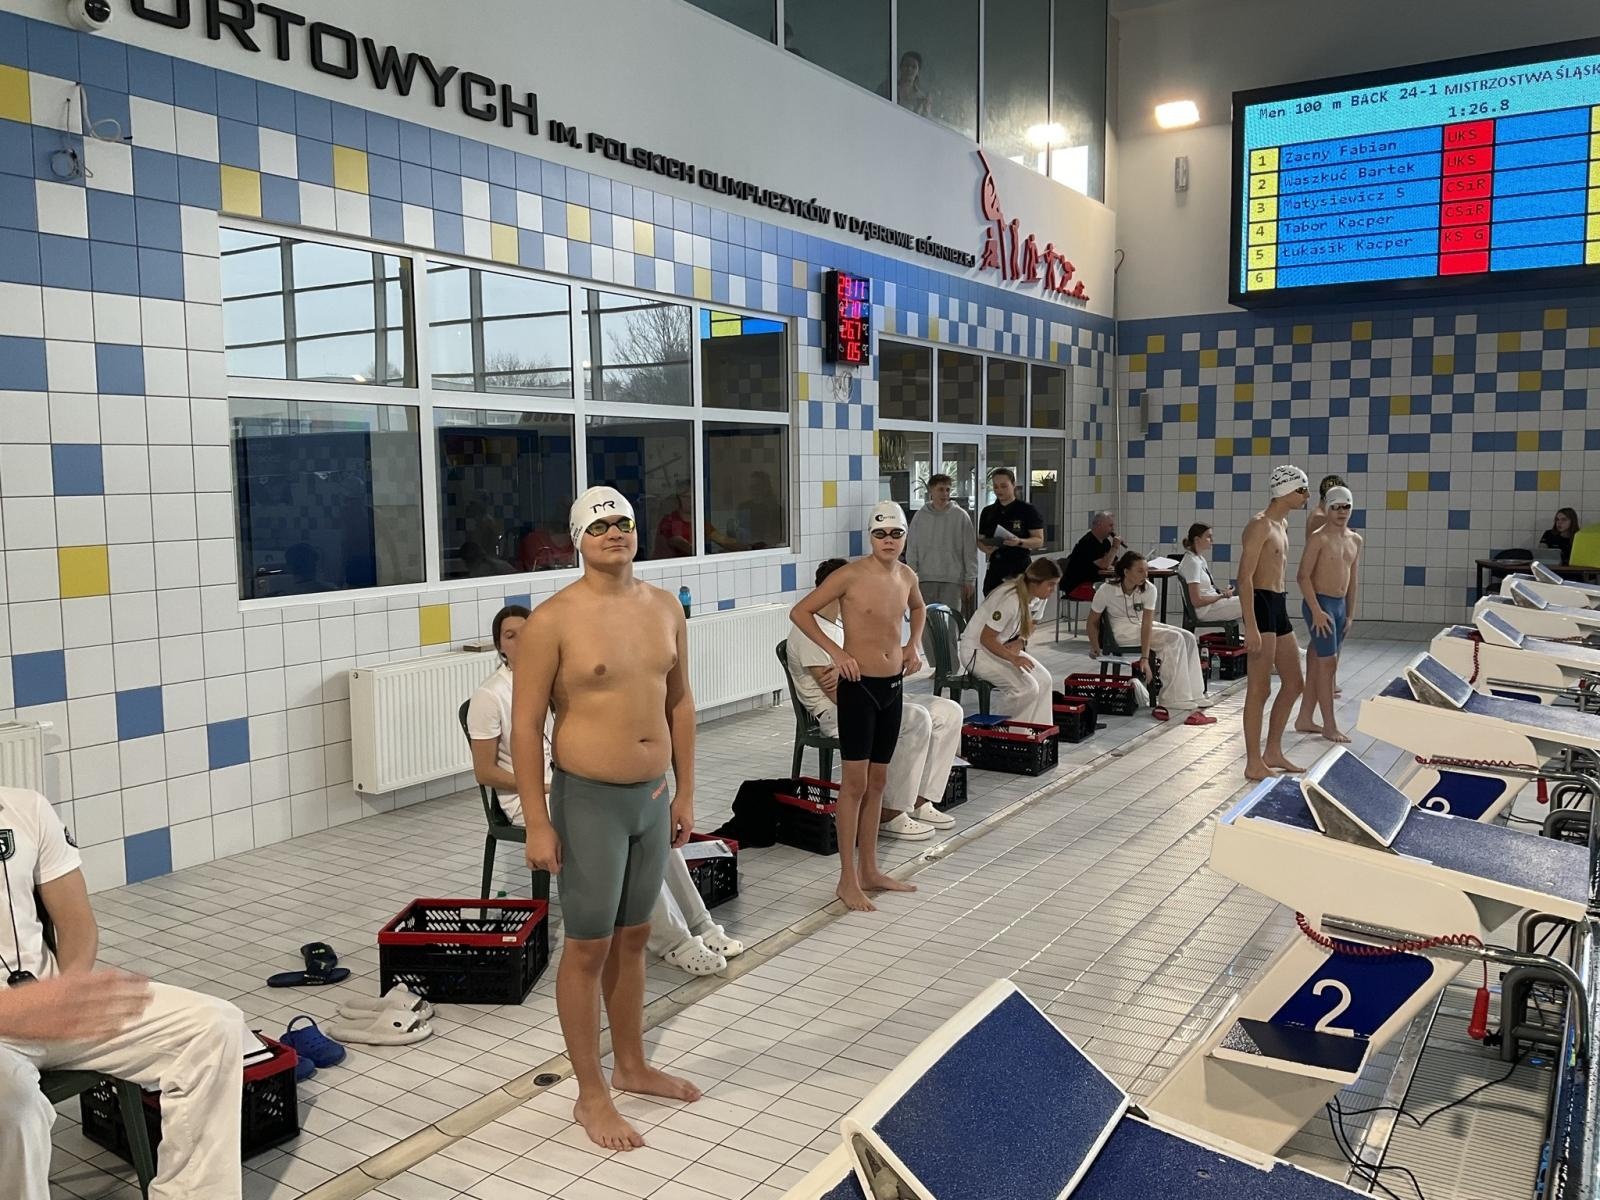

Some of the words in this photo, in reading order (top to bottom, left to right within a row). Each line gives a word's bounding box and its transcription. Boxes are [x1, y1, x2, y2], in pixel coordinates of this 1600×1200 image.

[1259, 107, 1286, 120] Men
[1295, 101, 1322, 115] 100
[1332, 101, 1342, 110] m
[1351, 90, 1389, 107] BACK
[1399, 84, 1438, 100] 24-1
[1444, 70, 1553, 96] MISTRZOSTWA
[1448, 99, 1510, 118] 1:26.8
[1258, 155, 1266, 167] 1
[1285, 149, 1330, 164] Zacny
[1340, 141, 1397, 156] Fabian
[1448, 129, 1477, 143] UKS
[1258, 179, 1266, 190] 2
[1284, 168, 1348, 187] Waszkuć
[1358, 162, 1415, 179] Bartek
[1447, 154, 1476, 167] UKS
[549, 120, 582, 149] IM.
[588, 132, 695, 184] POLSKICH
[699, 168, 831, 225] OLIMPIJCZYKÓW
[833, 211, 847, 230] W
[849, 216, 915, 250] DĄBROWIE
[916, 235, 976, 268] GÓRNICZEJ
[1257, 203, 1265, 214] 3
[1283, 192, 1385, 210] Matysiewicz
[1396, 187, 1405, 198] S
[1446, 178, 1485, 193] CSiR
[1256, 226, 1264, 237] 4
[1284, 221, 1328, 234] Tabor
[1338, 215, 1394, 228] Kacper
[1445, 203, 1484, 217] CSiR
[1256, 249, 1264, 260] 5
[1282, 241, 1346, 257] Łukasik
[1356, 238, 1413, 251] Kacper
[1444, 230, 1463, 243] KS
[1255, 273, 1263, 284] 6
[590, 500, 616, 514] TYR
[1312, 978, 1355, 1037] 2
